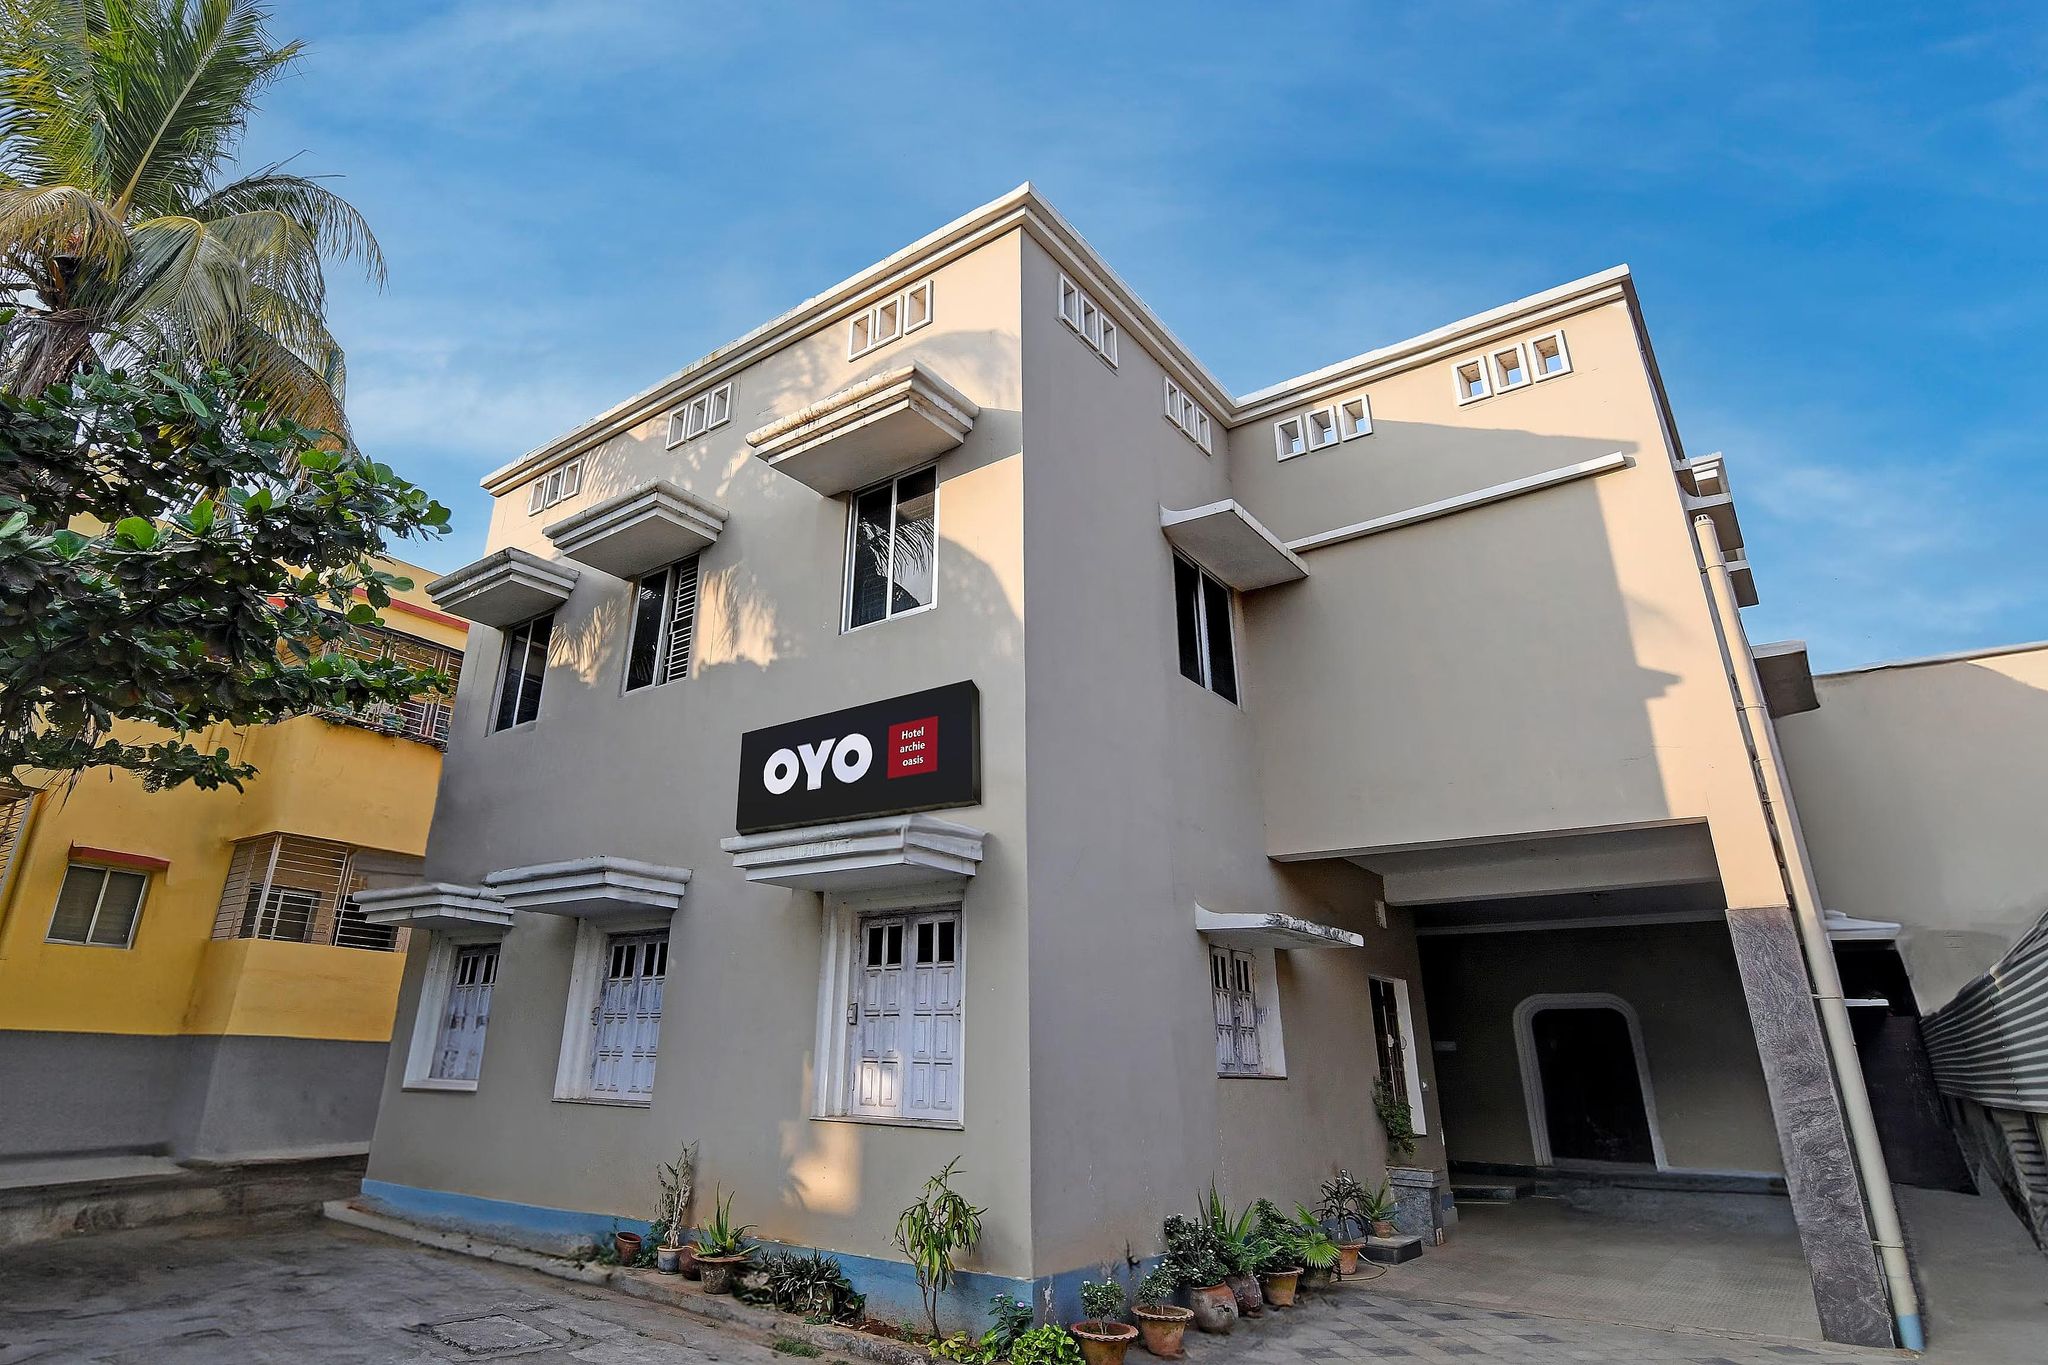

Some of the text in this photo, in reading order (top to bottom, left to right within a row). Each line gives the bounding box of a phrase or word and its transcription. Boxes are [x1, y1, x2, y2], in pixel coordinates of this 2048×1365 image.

[901, 726, 925, 740] Hotel
[899, 741, 926, 754] archie
[763, 733, 873, 795] OYO
[902, 755, 924, 767] oasis
